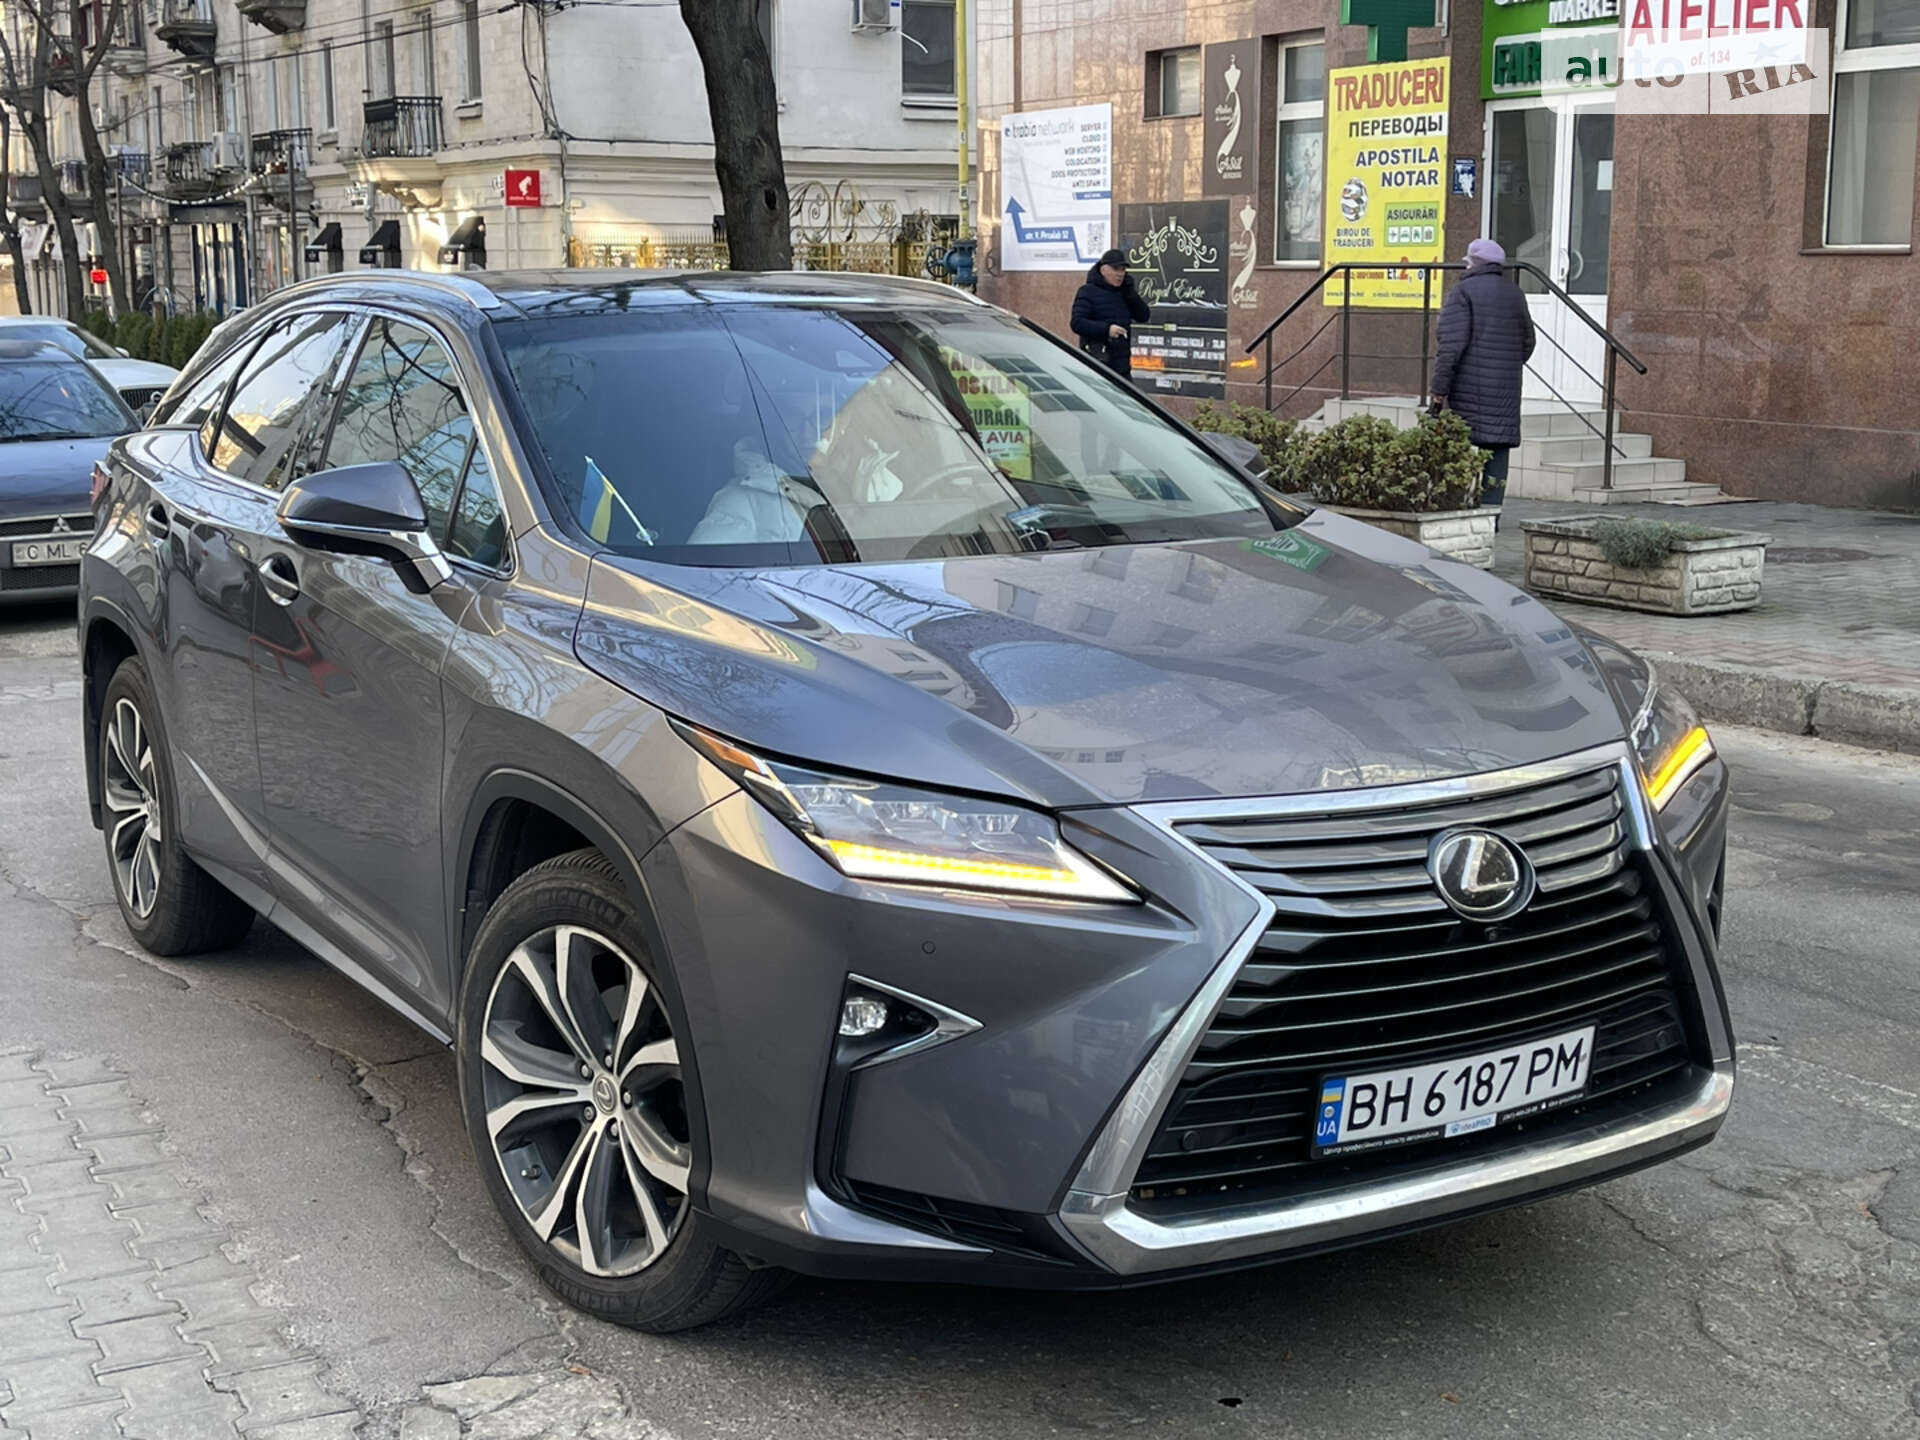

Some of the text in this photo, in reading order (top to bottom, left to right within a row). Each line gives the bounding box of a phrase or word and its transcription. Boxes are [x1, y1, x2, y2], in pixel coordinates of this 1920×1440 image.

[1549, 0, 1617, 23] MARKE
[1709, 48, 1731, 65] 134
[1334, 66, 1445, 112] TRADUCERI
[1349, 115, 1443, 138] ПЕРЕВОДЫ
[1355, 147, 1439, 168] APOSTILA
[1381, 169, 1438, 187] NOTAR
[1336, 227, 1371, 238] BIROU DE
[1332, 237, 1374, 248] TRADUCERI
[986, 431, 1024, 444] AVIA
[47, 543, 72, 559] ML
[1346, 1037, 1585, 1132] BH 6187 PM
[1316, 1120, 1337, 1137] UA
